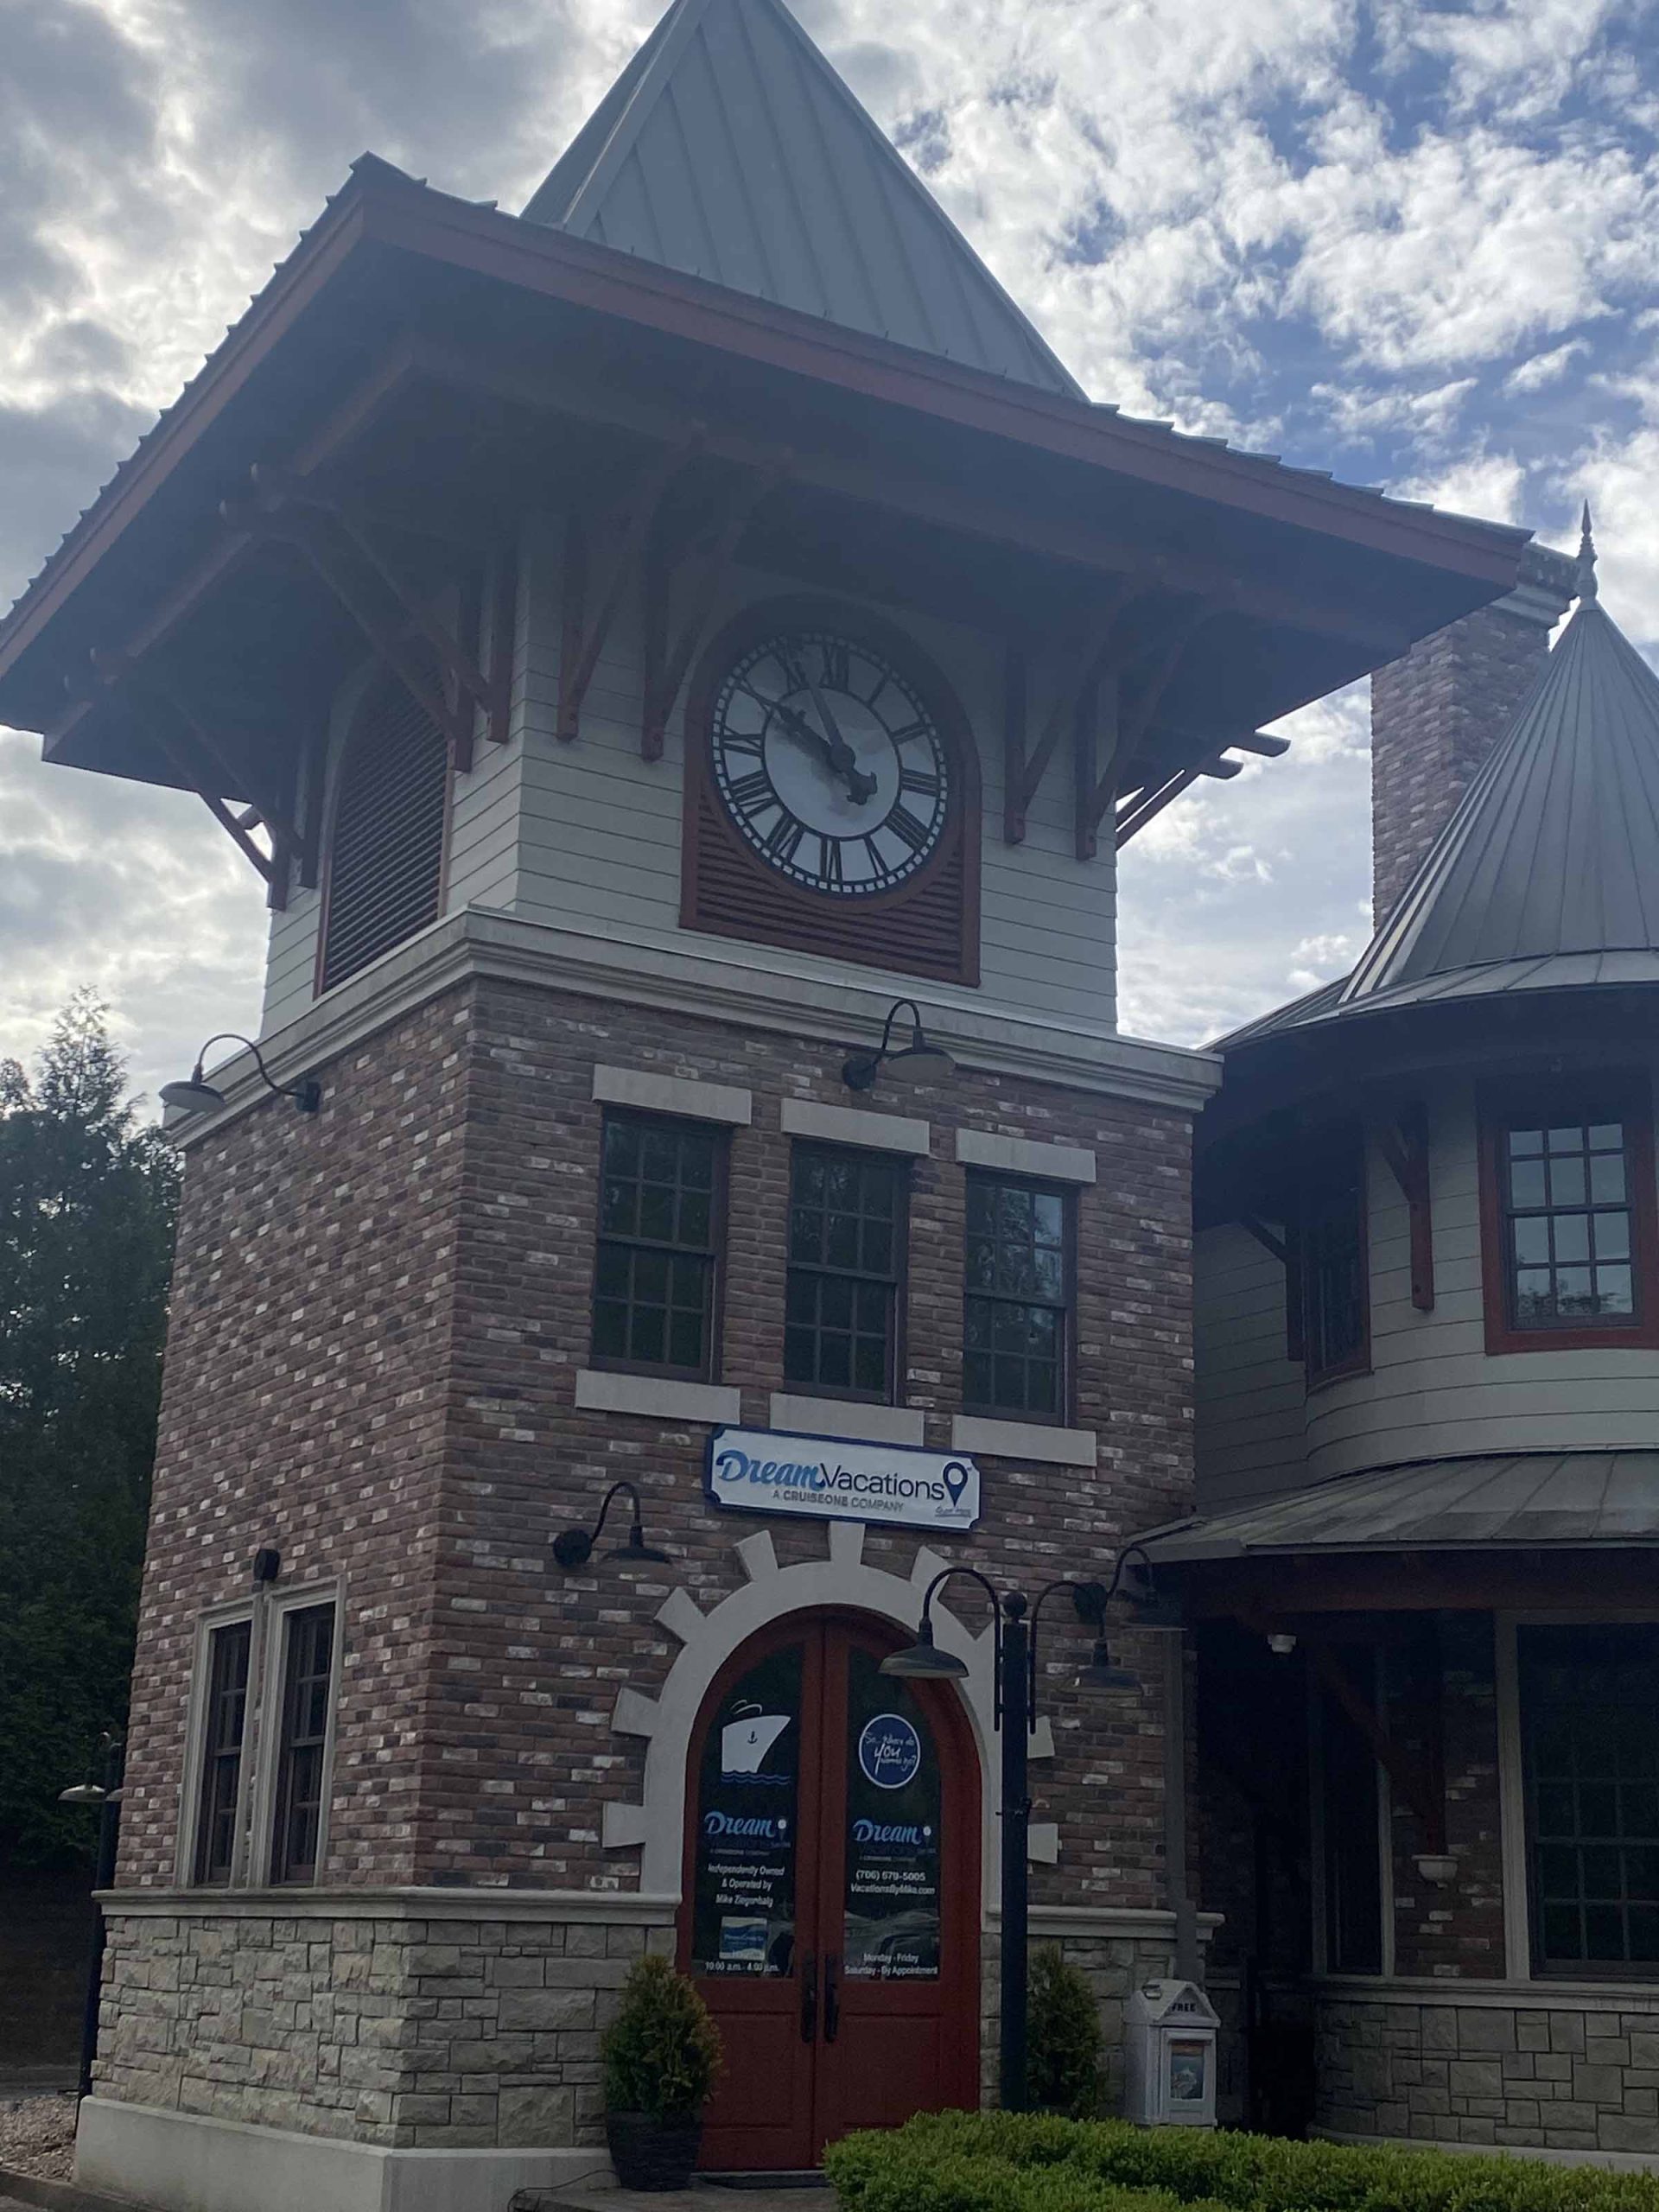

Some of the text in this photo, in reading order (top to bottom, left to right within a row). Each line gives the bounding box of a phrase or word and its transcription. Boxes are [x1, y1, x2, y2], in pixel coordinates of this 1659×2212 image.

[715, 1449, 944, 1502] Dream Vacations
[772, 1490, 904, 1513] A CRUISEONE COMPANY
[704, 1810, 776, 1838] Dream
[851, 1819, 923, 1845] Dream
[707, 1862, 785, 1878] Independently Owned
[728, 1878, 762, 1890] Operated
[762, 1879, 772, 1891] by
[897, 1952, 920, 1964] Friday
[892, 1965, 938, 1977] Appointment
[1172, 2002, 1198, 2012] FREE
